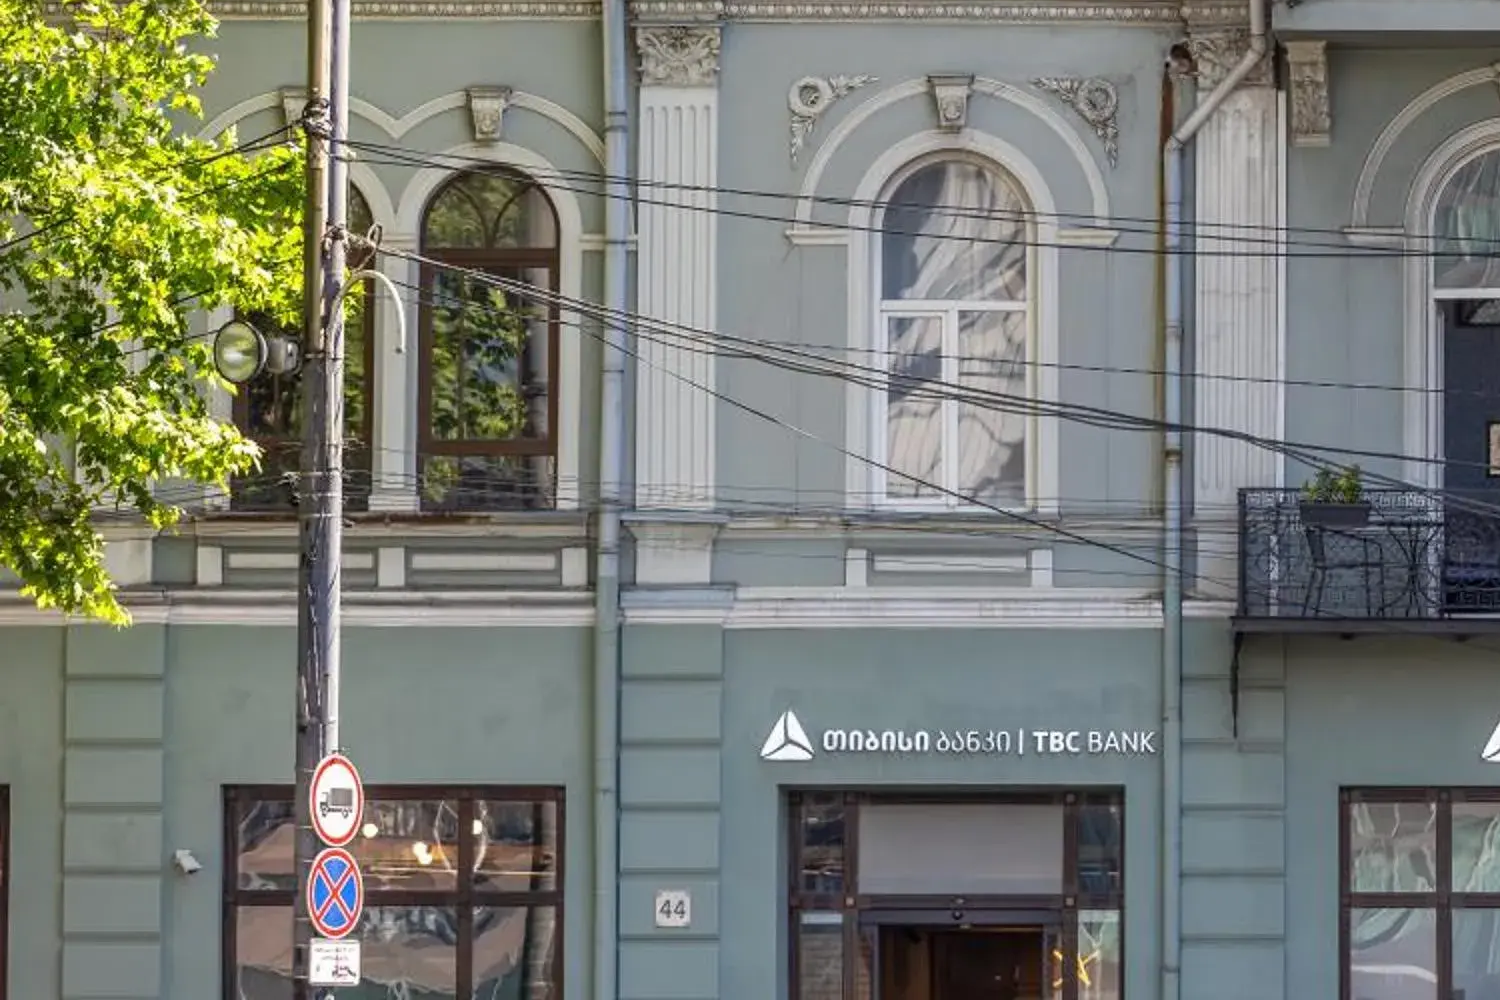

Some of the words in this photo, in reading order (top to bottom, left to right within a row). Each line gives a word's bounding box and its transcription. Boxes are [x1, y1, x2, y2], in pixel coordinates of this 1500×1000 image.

[822, 729, 929, 752] თიბისი
[936, 730, 1010, 753] ბანკი
[1032, 731, 1081, 753] TBC
[1087, 731, 1157, 753] BANK
[659, 899, 686, 919] 44
